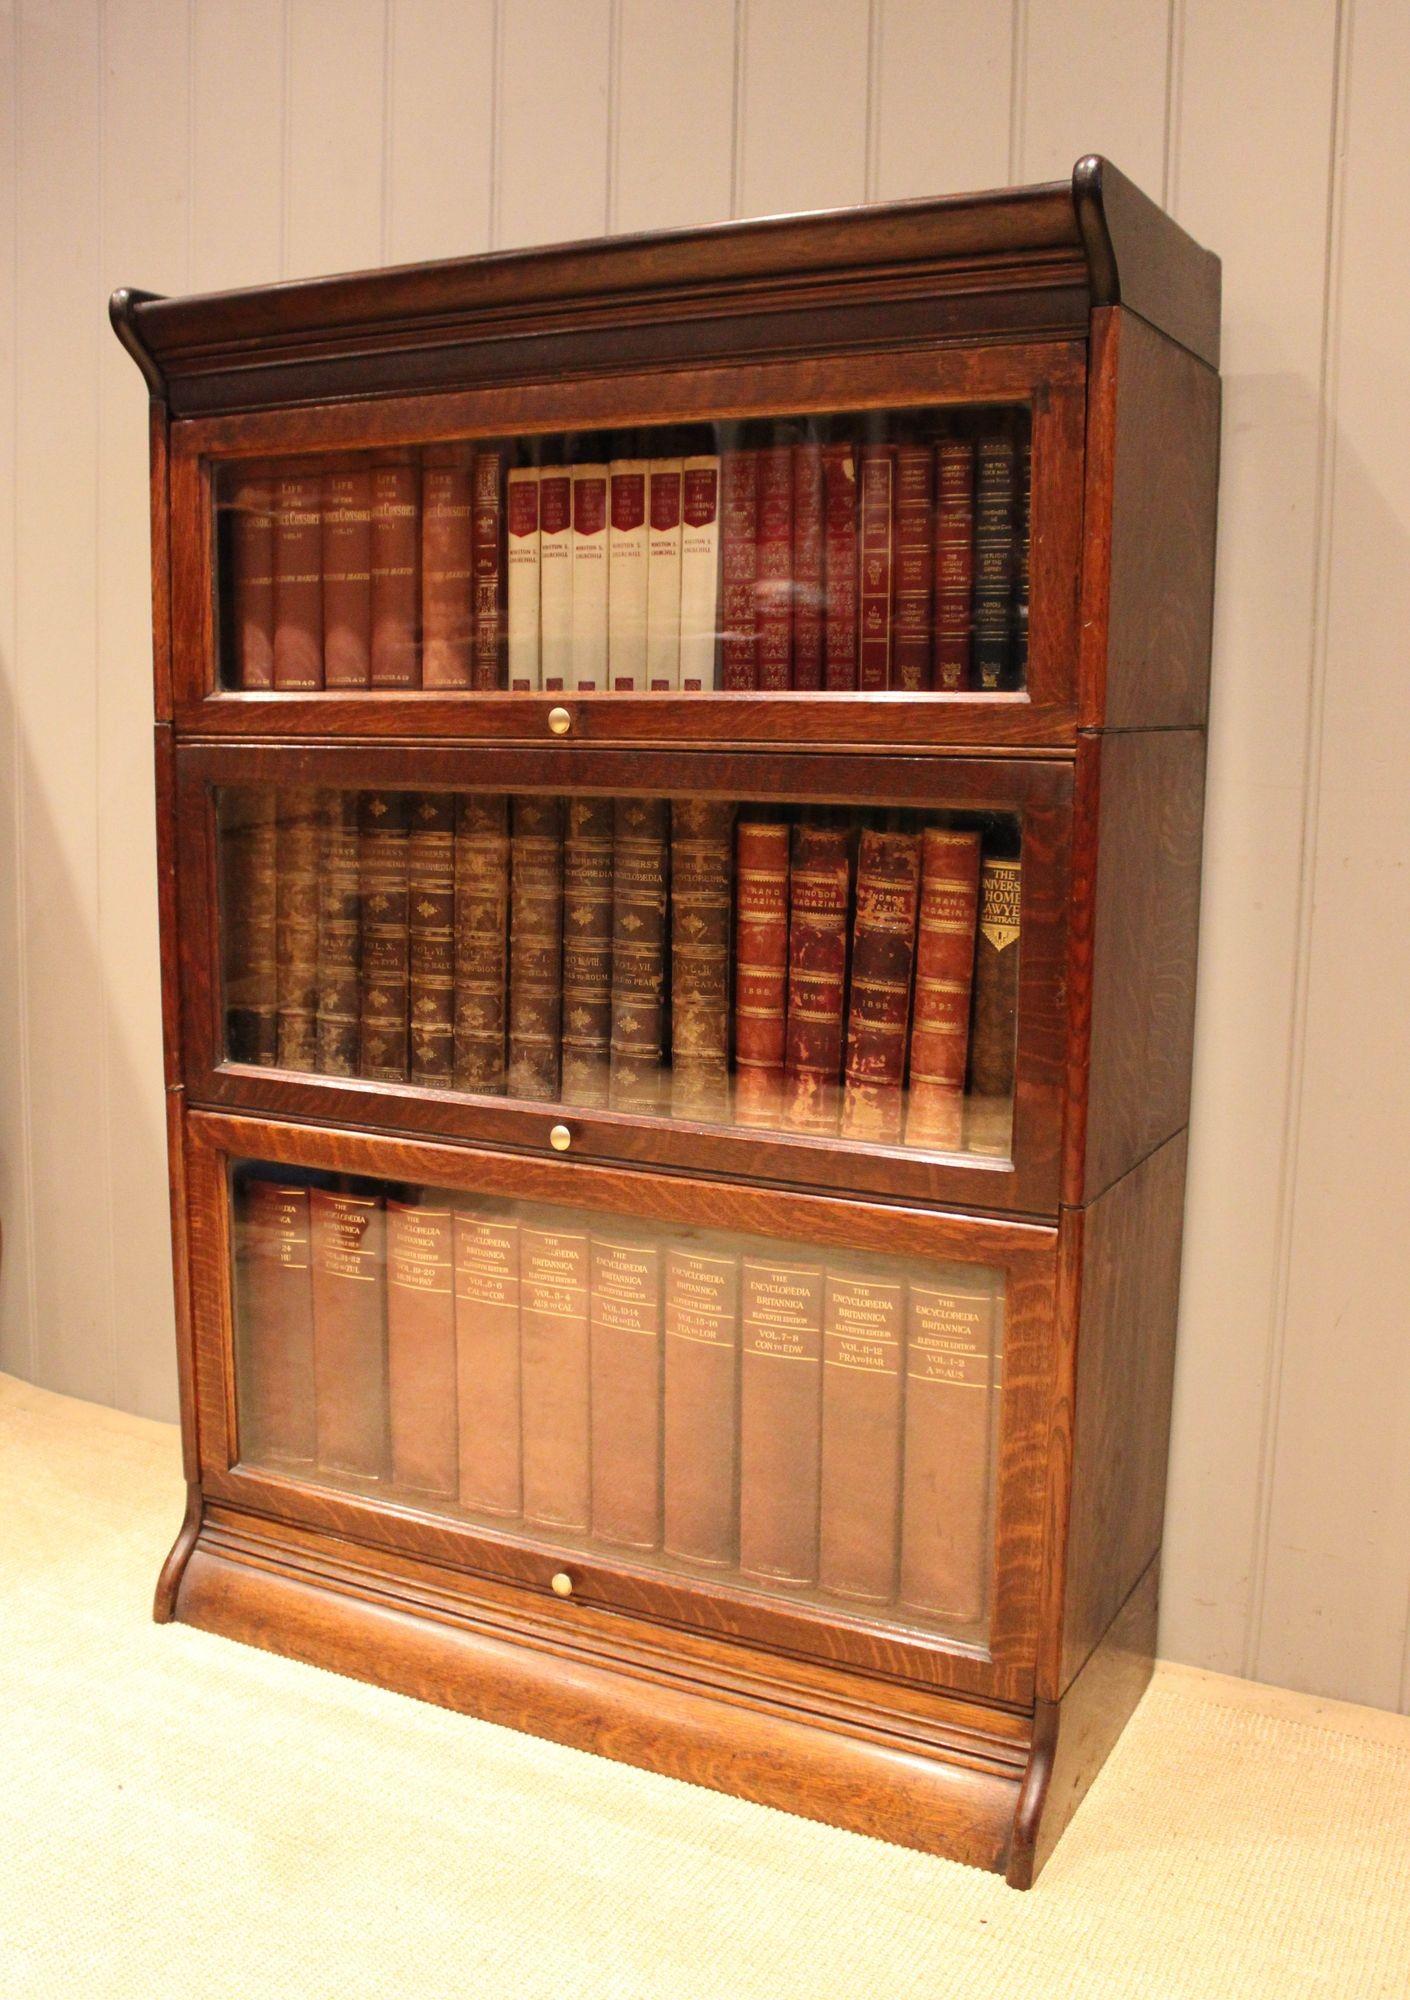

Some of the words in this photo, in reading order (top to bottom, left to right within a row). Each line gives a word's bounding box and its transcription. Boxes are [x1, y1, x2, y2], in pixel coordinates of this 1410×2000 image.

[994, 869, 1016, 880] THE
[984, 878, 1021, 892] NIVERS
[746, 886, 780, 896] TRAND
[929, 896, 967, 906] TRAND
[984, 902, 1021, 917] AWYE
[612, 1251, 627, 1260] THE
[690, 1261, 703, 1270] THE
[772, 1274, 788, 1283] THE
[853, 1287, 870, 1296] THE
[938, 1298, 956, 1308] THE
[783, 1344, 804, 1354] EDW
[866, 1357, 885, 1367] HAR
[944, 1369, 965, 1380] AUS
